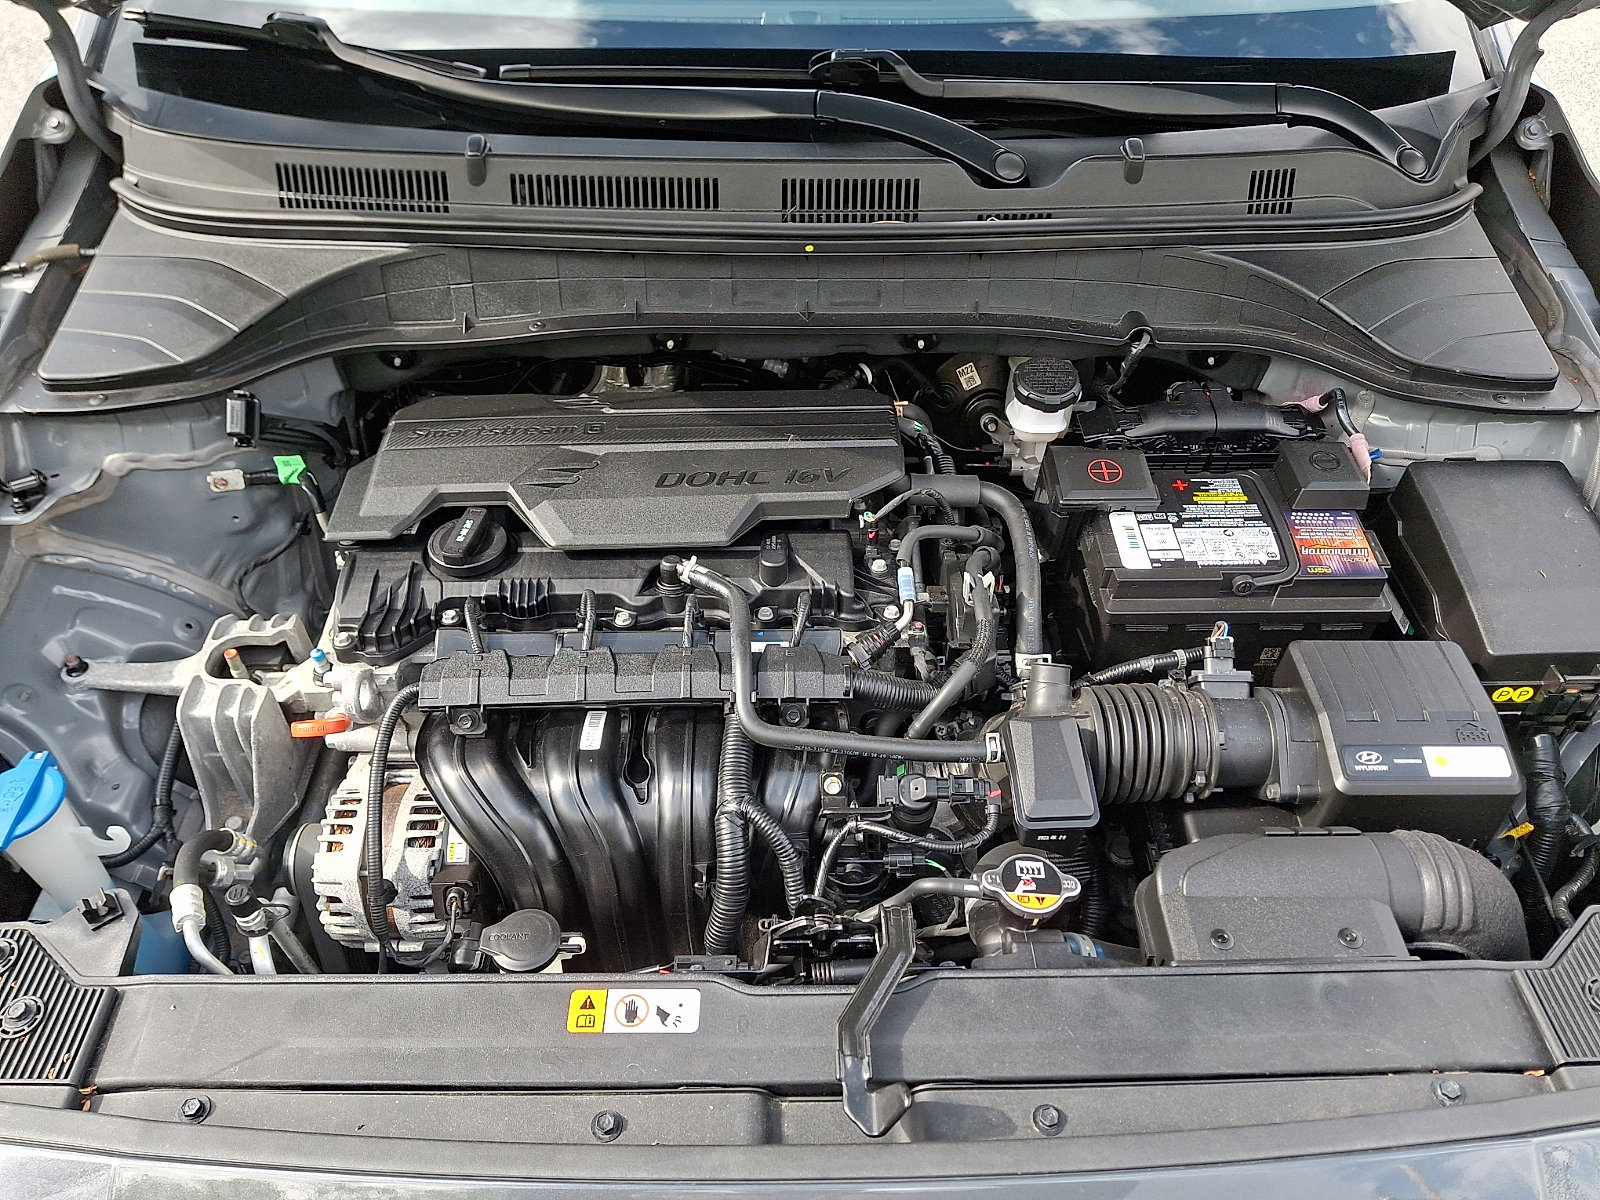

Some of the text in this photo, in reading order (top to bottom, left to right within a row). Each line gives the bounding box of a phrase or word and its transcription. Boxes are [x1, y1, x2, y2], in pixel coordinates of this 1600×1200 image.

[957, 363, 975, 378] M22
[409, 423, 578, 439] Smartstream
[655, 467, 854, 489] DOHC 16V
[1301, 545, 1369, 558] INTIMIDATOR
[488, 932, 530, 941] COOLANT
